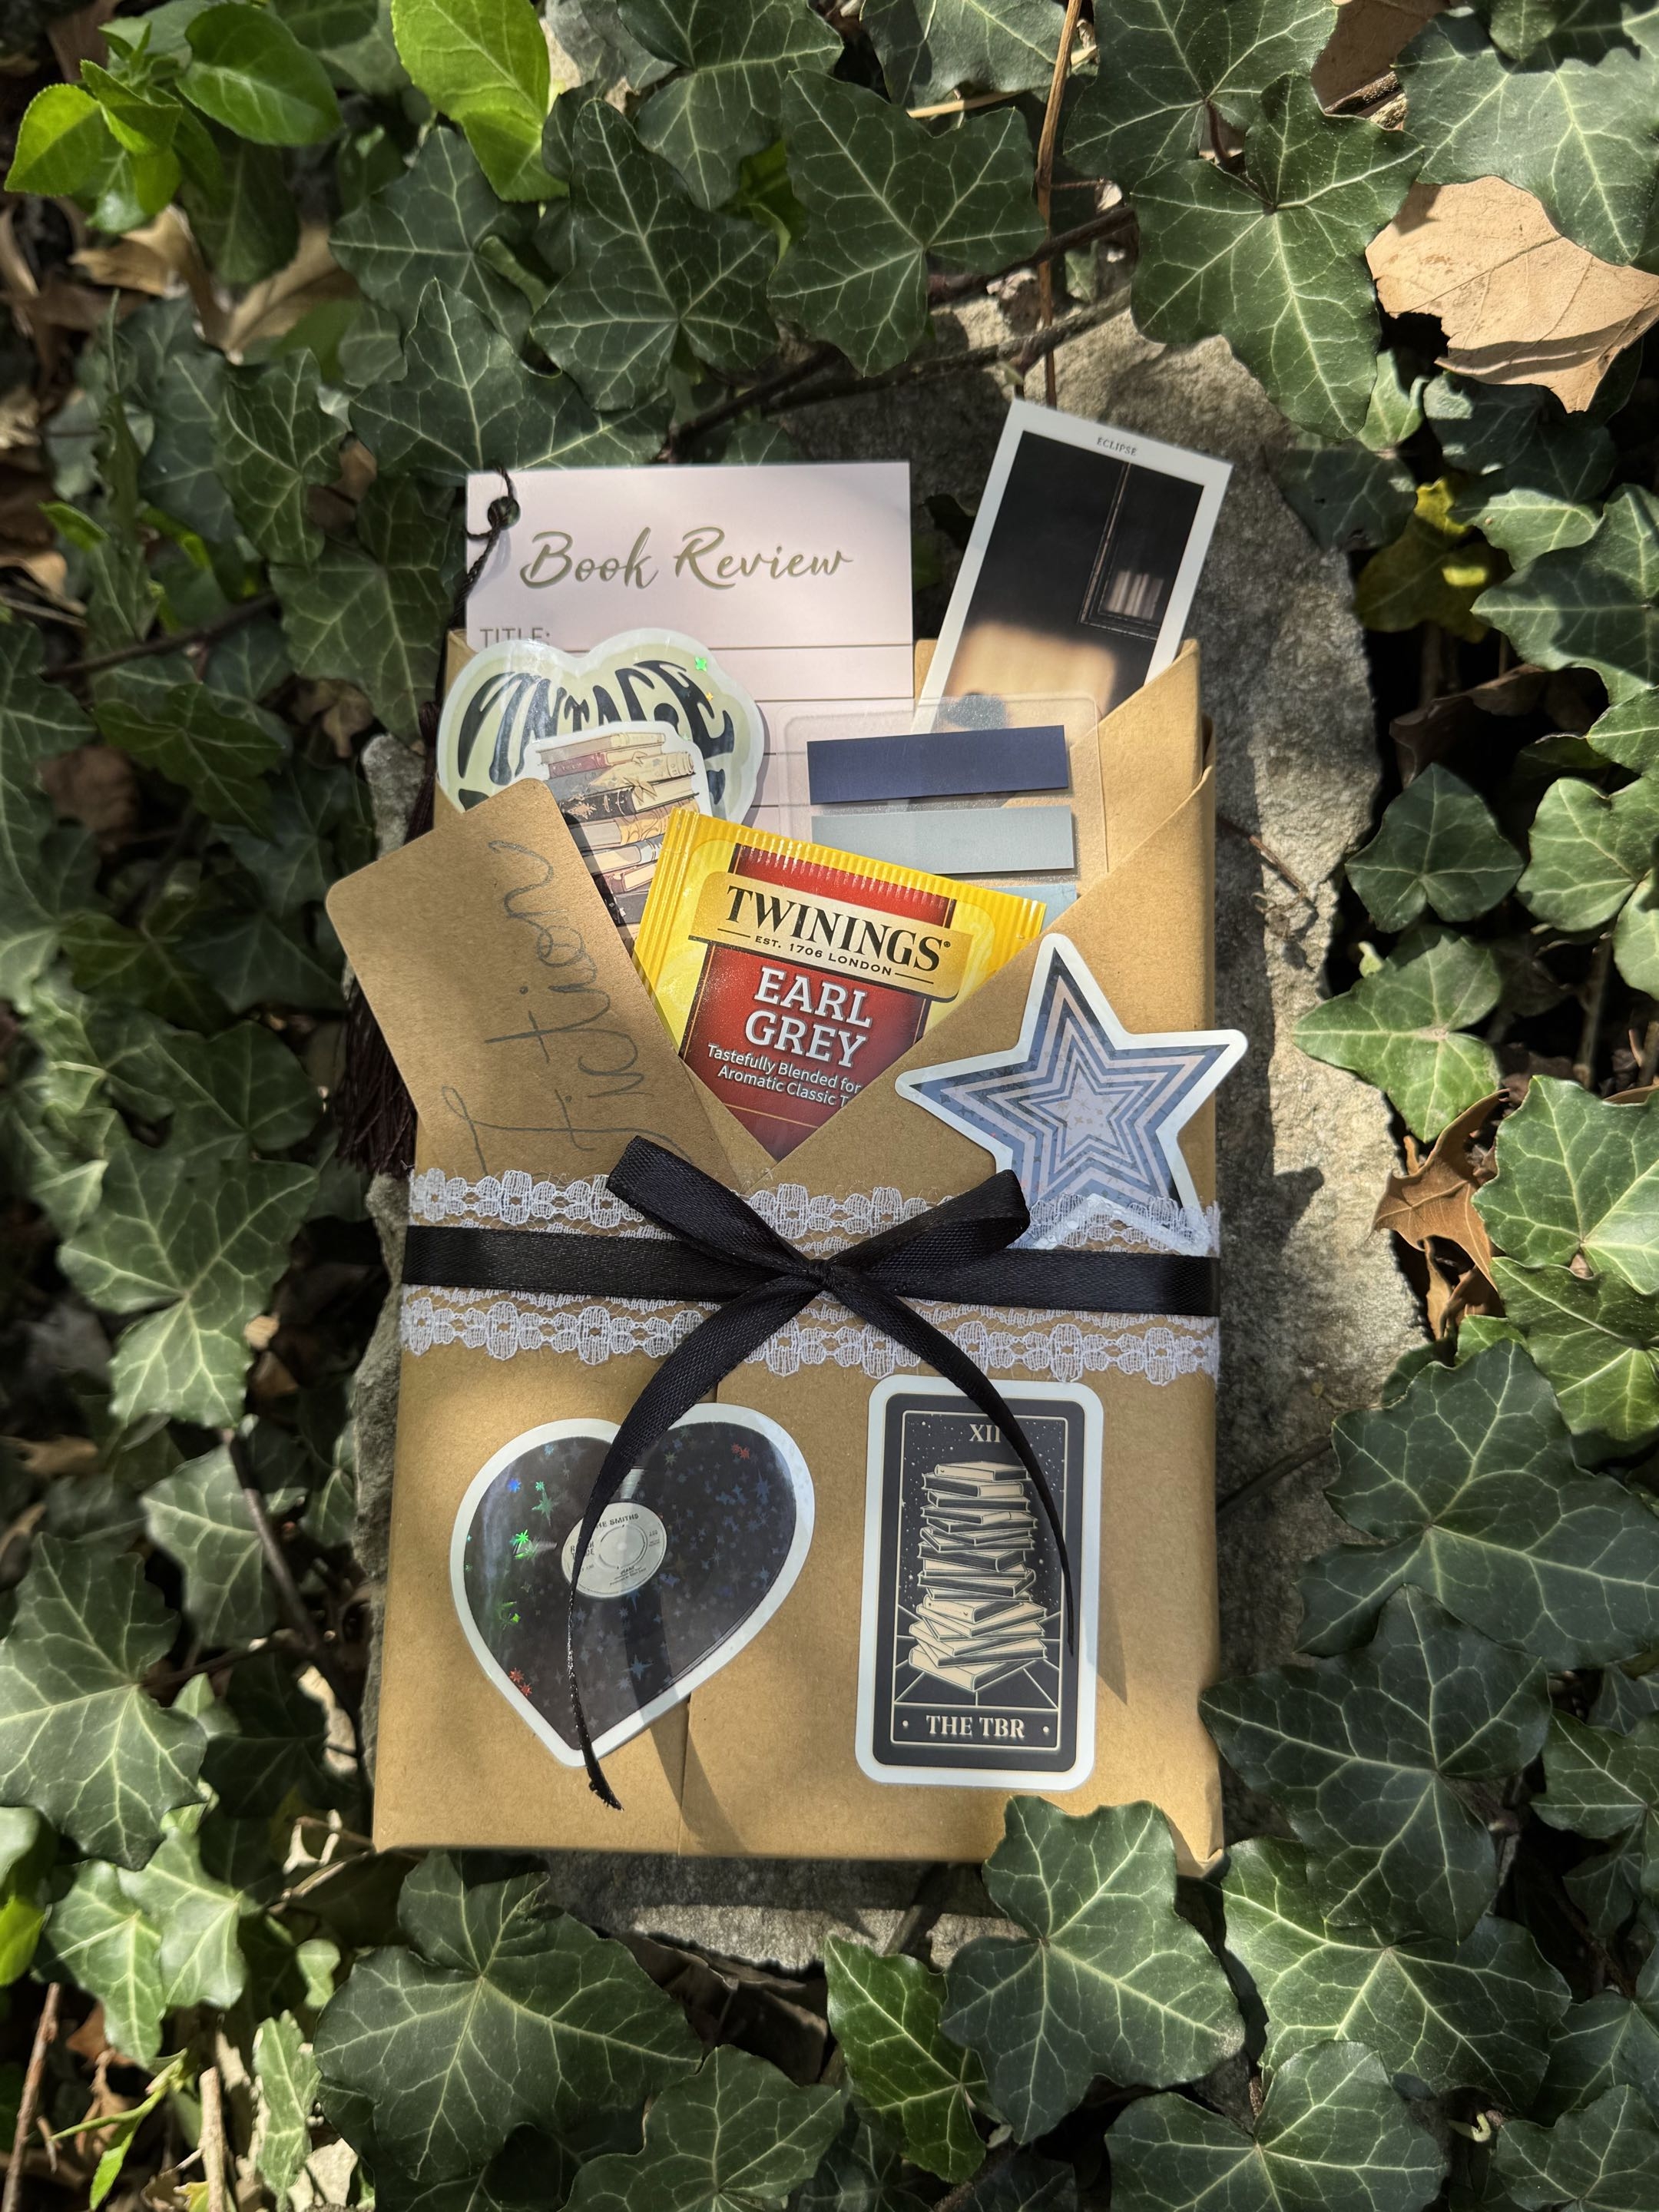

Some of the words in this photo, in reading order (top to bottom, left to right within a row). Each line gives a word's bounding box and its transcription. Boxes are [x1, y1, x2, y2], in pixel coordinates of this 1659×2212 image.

[1097, 436, 1137, 456] ECLIPSE
[519, 526, 659, 590] Book
[674, 525, 853, 591] Review
[755, 935, 782, 949] EST.
[789, 943, 823, 959] 1706
[828, 952, 892, 976] LONDON
[441, 839, 691, 1176] Fiction
[753, 966, 873, 1028] EARL
[745, 1009, 868, 1068] GREY
[707, 1044, 777, 1075] Tastefully
[777, 1062, 838, 1089] Blended
[840, 1077, 862, 1094] for
[717, 1065, 784, 1092] Aromatic
[786, 1081, 836, 1106] Classic
[926, 1714, 973, 1736] THE
[979, 1716, 1025, 1738] TBR
